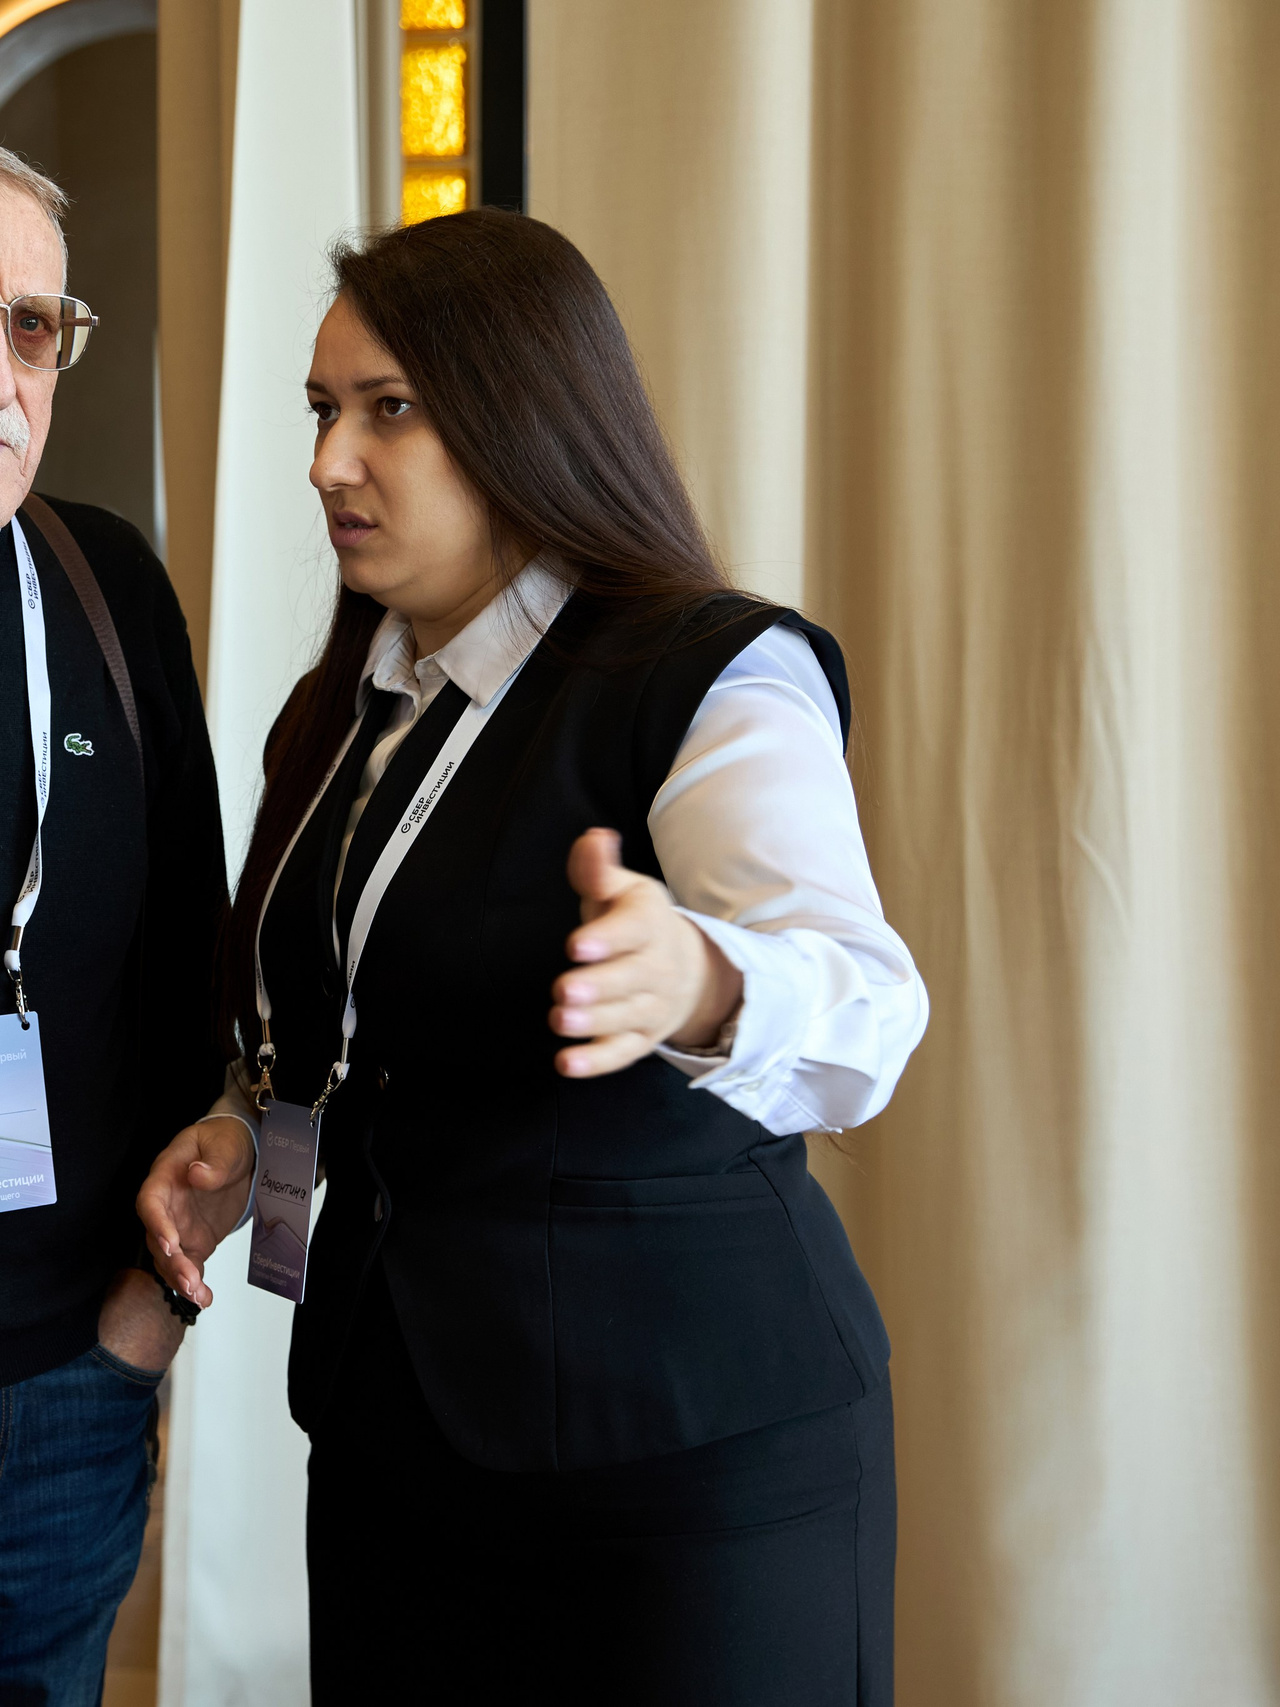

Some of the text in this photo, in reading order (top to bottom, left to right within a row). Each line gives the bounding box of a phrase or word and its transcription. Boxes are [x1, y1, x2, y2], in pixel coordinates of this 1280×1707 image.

[414, 761, 455, 824] ИНВЕСТИЦИИ
[408, 796, 425, 821] СБЕР
[274, 1135, 289, 1148] СБЕР
[261, 1169, 307, 1201] Валентина
